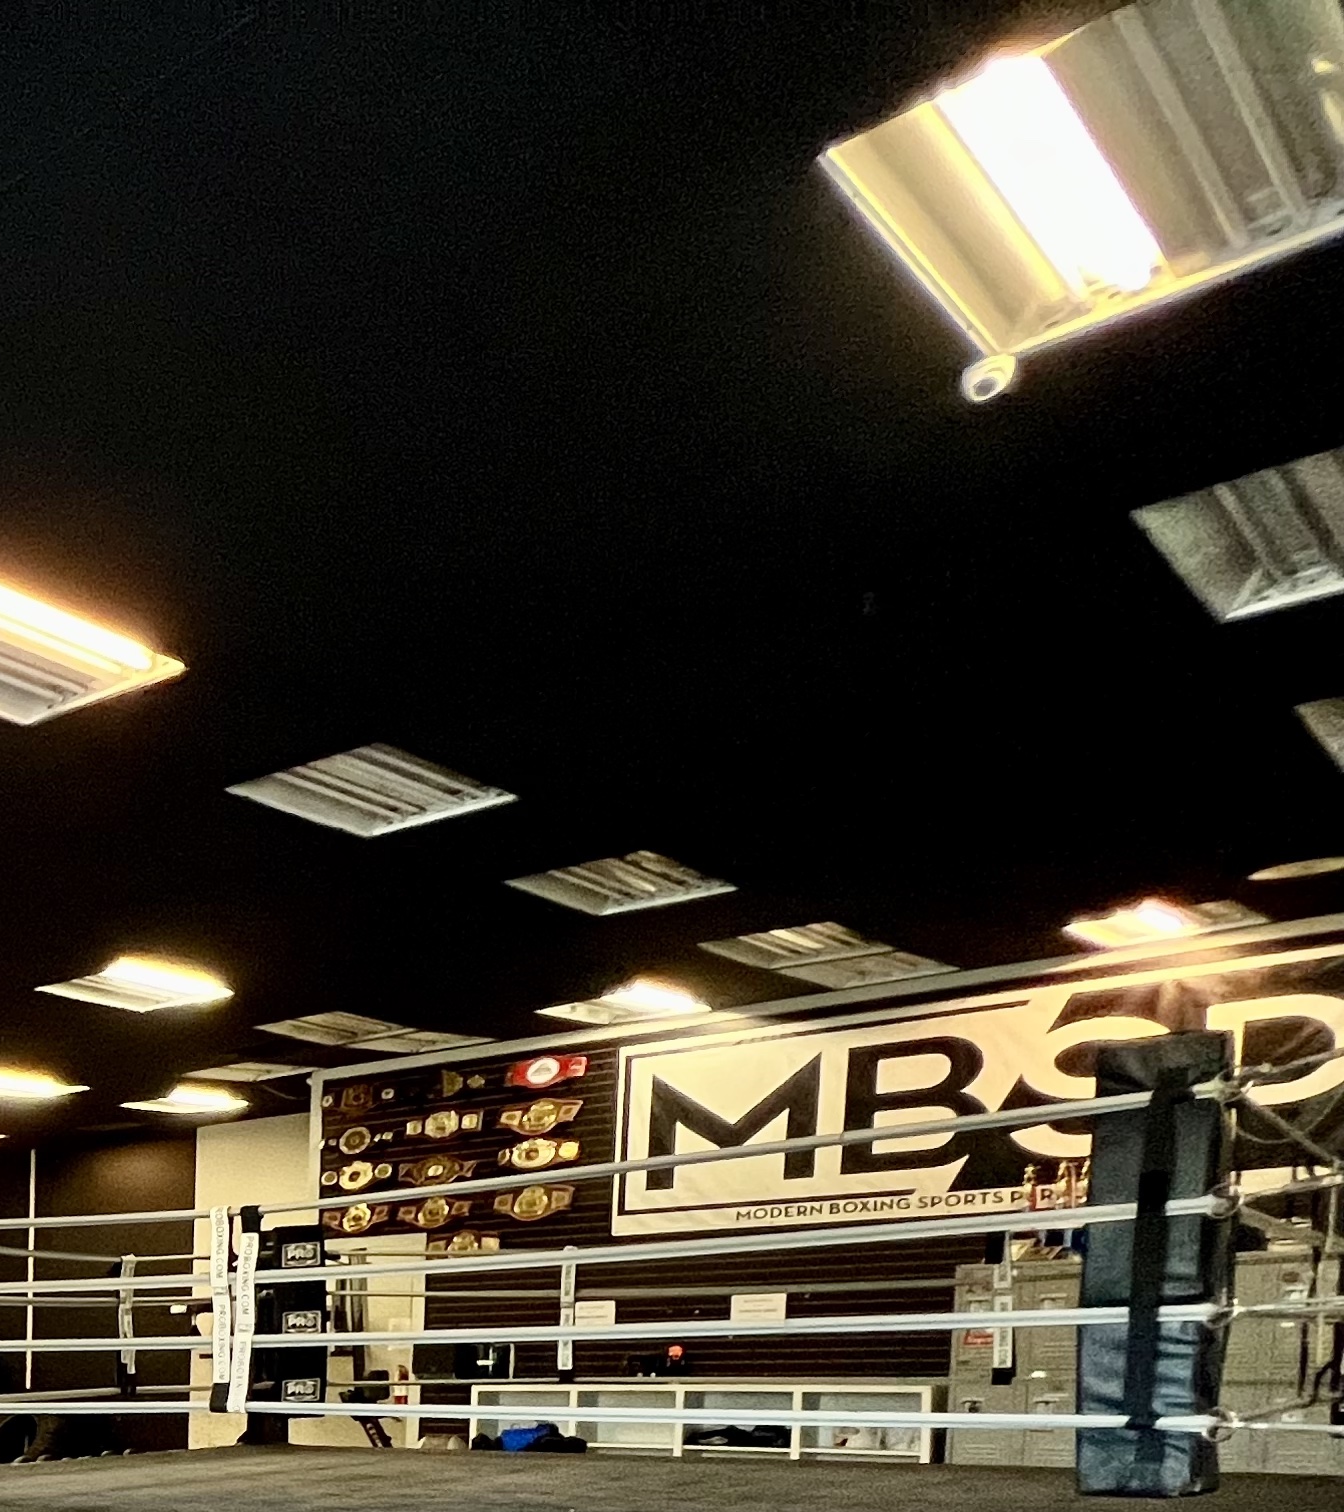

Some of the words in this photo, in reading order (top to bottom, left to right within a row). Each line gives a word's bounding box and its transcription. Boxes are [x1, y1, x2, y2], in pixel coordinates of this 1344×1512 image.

[735, 1203, 824, 1221] MODERN
[828, 1197, 911, 1215] BOXING
[916, 1190, 1004, 1209] SPORTS
